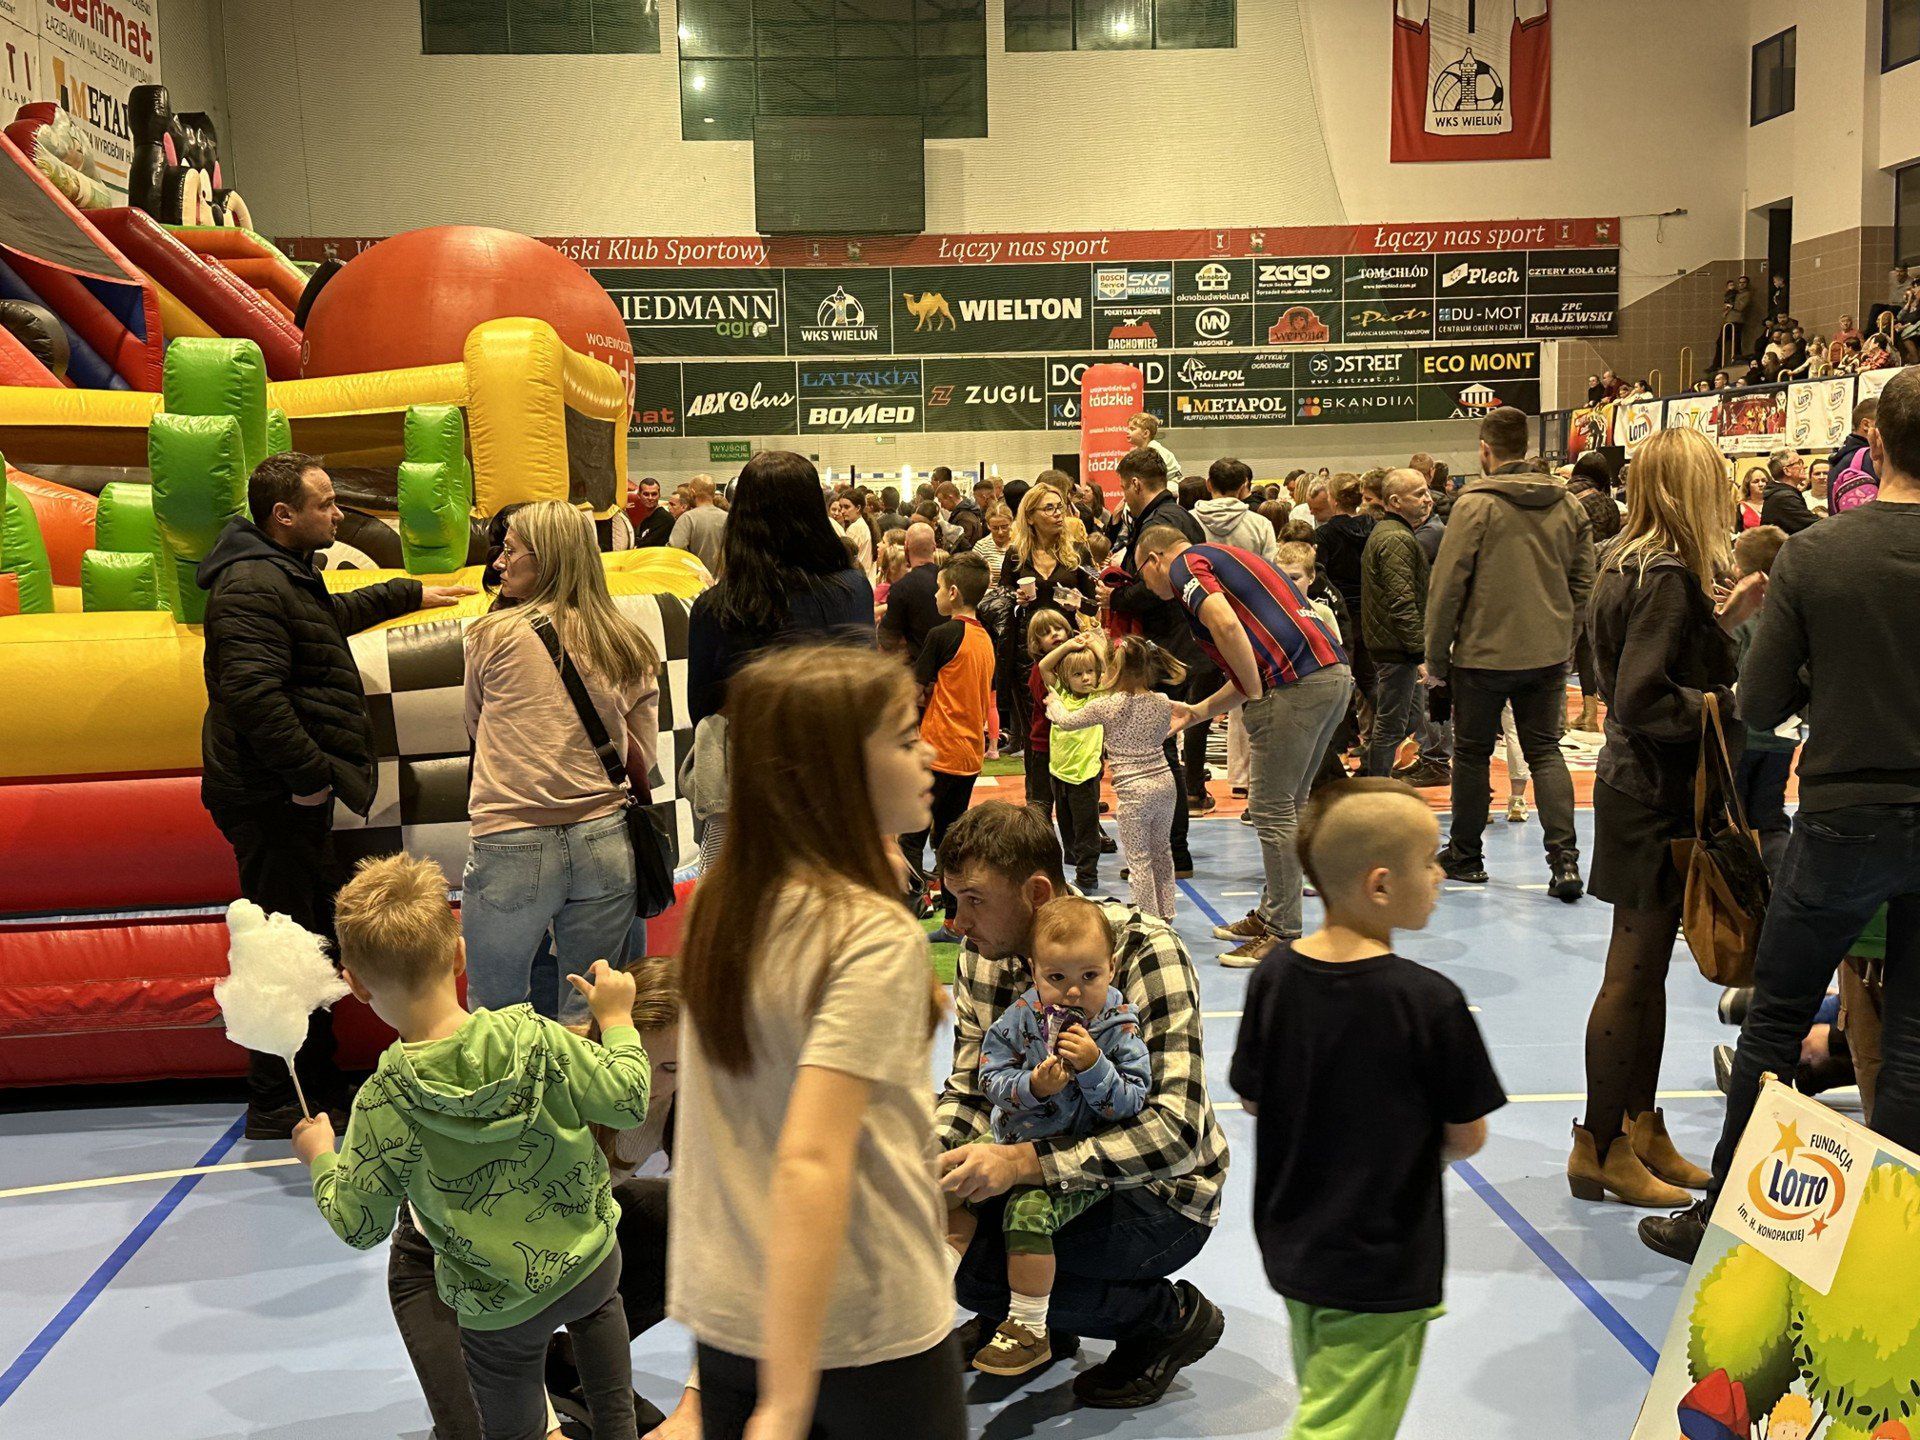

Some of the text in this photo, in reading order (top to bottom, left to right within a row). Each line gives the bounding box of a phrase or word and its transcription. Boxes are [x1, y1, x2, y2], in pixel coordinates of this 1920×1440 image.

[1435, 113, 1502, 127] WKS WIELUŃ
[1374, 224, 1546, 252] Łączy nas sport
[607, 238, 660, 260] Klub
[664, 239, 771, 266] Sportowy
[938, 236, 1110, 262] Łączy nas sport
[1466, 267, 1520, 284] Plech
[1528, 266, 1617, 275] CZTERY KOŁA GAZ
[1127, 273, 1170, 286] SKP
[1176, 291, 1250, 302] oknobudwielun.pl
[621, 295, 773, 320] IEDMANN
[958, 297, 1082, 321] WIELTON
[1452, 307, 1474, 320] DU
[1485, 306, 1522, 320] MOT
[1561, 302, 1583, 311] ZPC
[1529, 311, 1614, 324] KRAJEWSKI
[801, 328, 878, 341] WKS WIELUŃ
[1438, 325, 1472, 333] CENTRUM
[1499, 323, 1522, 331] DRZWI
[1108, 338, 1158, 349] DACHOWIEC
[1424, 352, 1535, 374] ECO MONT
[803, 370, 919, 387] LATAKIA
[1193, 369, 1245, 381] ROLPOL
[965, 385, 1042, 404] ZUGIL
[1089, 393, 1134, 407] łódzkie
[1193, 397, 1287, 413] METAPOL
[1810, 1134, 1853, 1173] FUNDACJA
[1768, 1158, 1829, 1208] LOTTO
[1749, 1218, 1756, 1231] H.
[1756, 1222, 1805, 1243] KONOPACKIEJ
